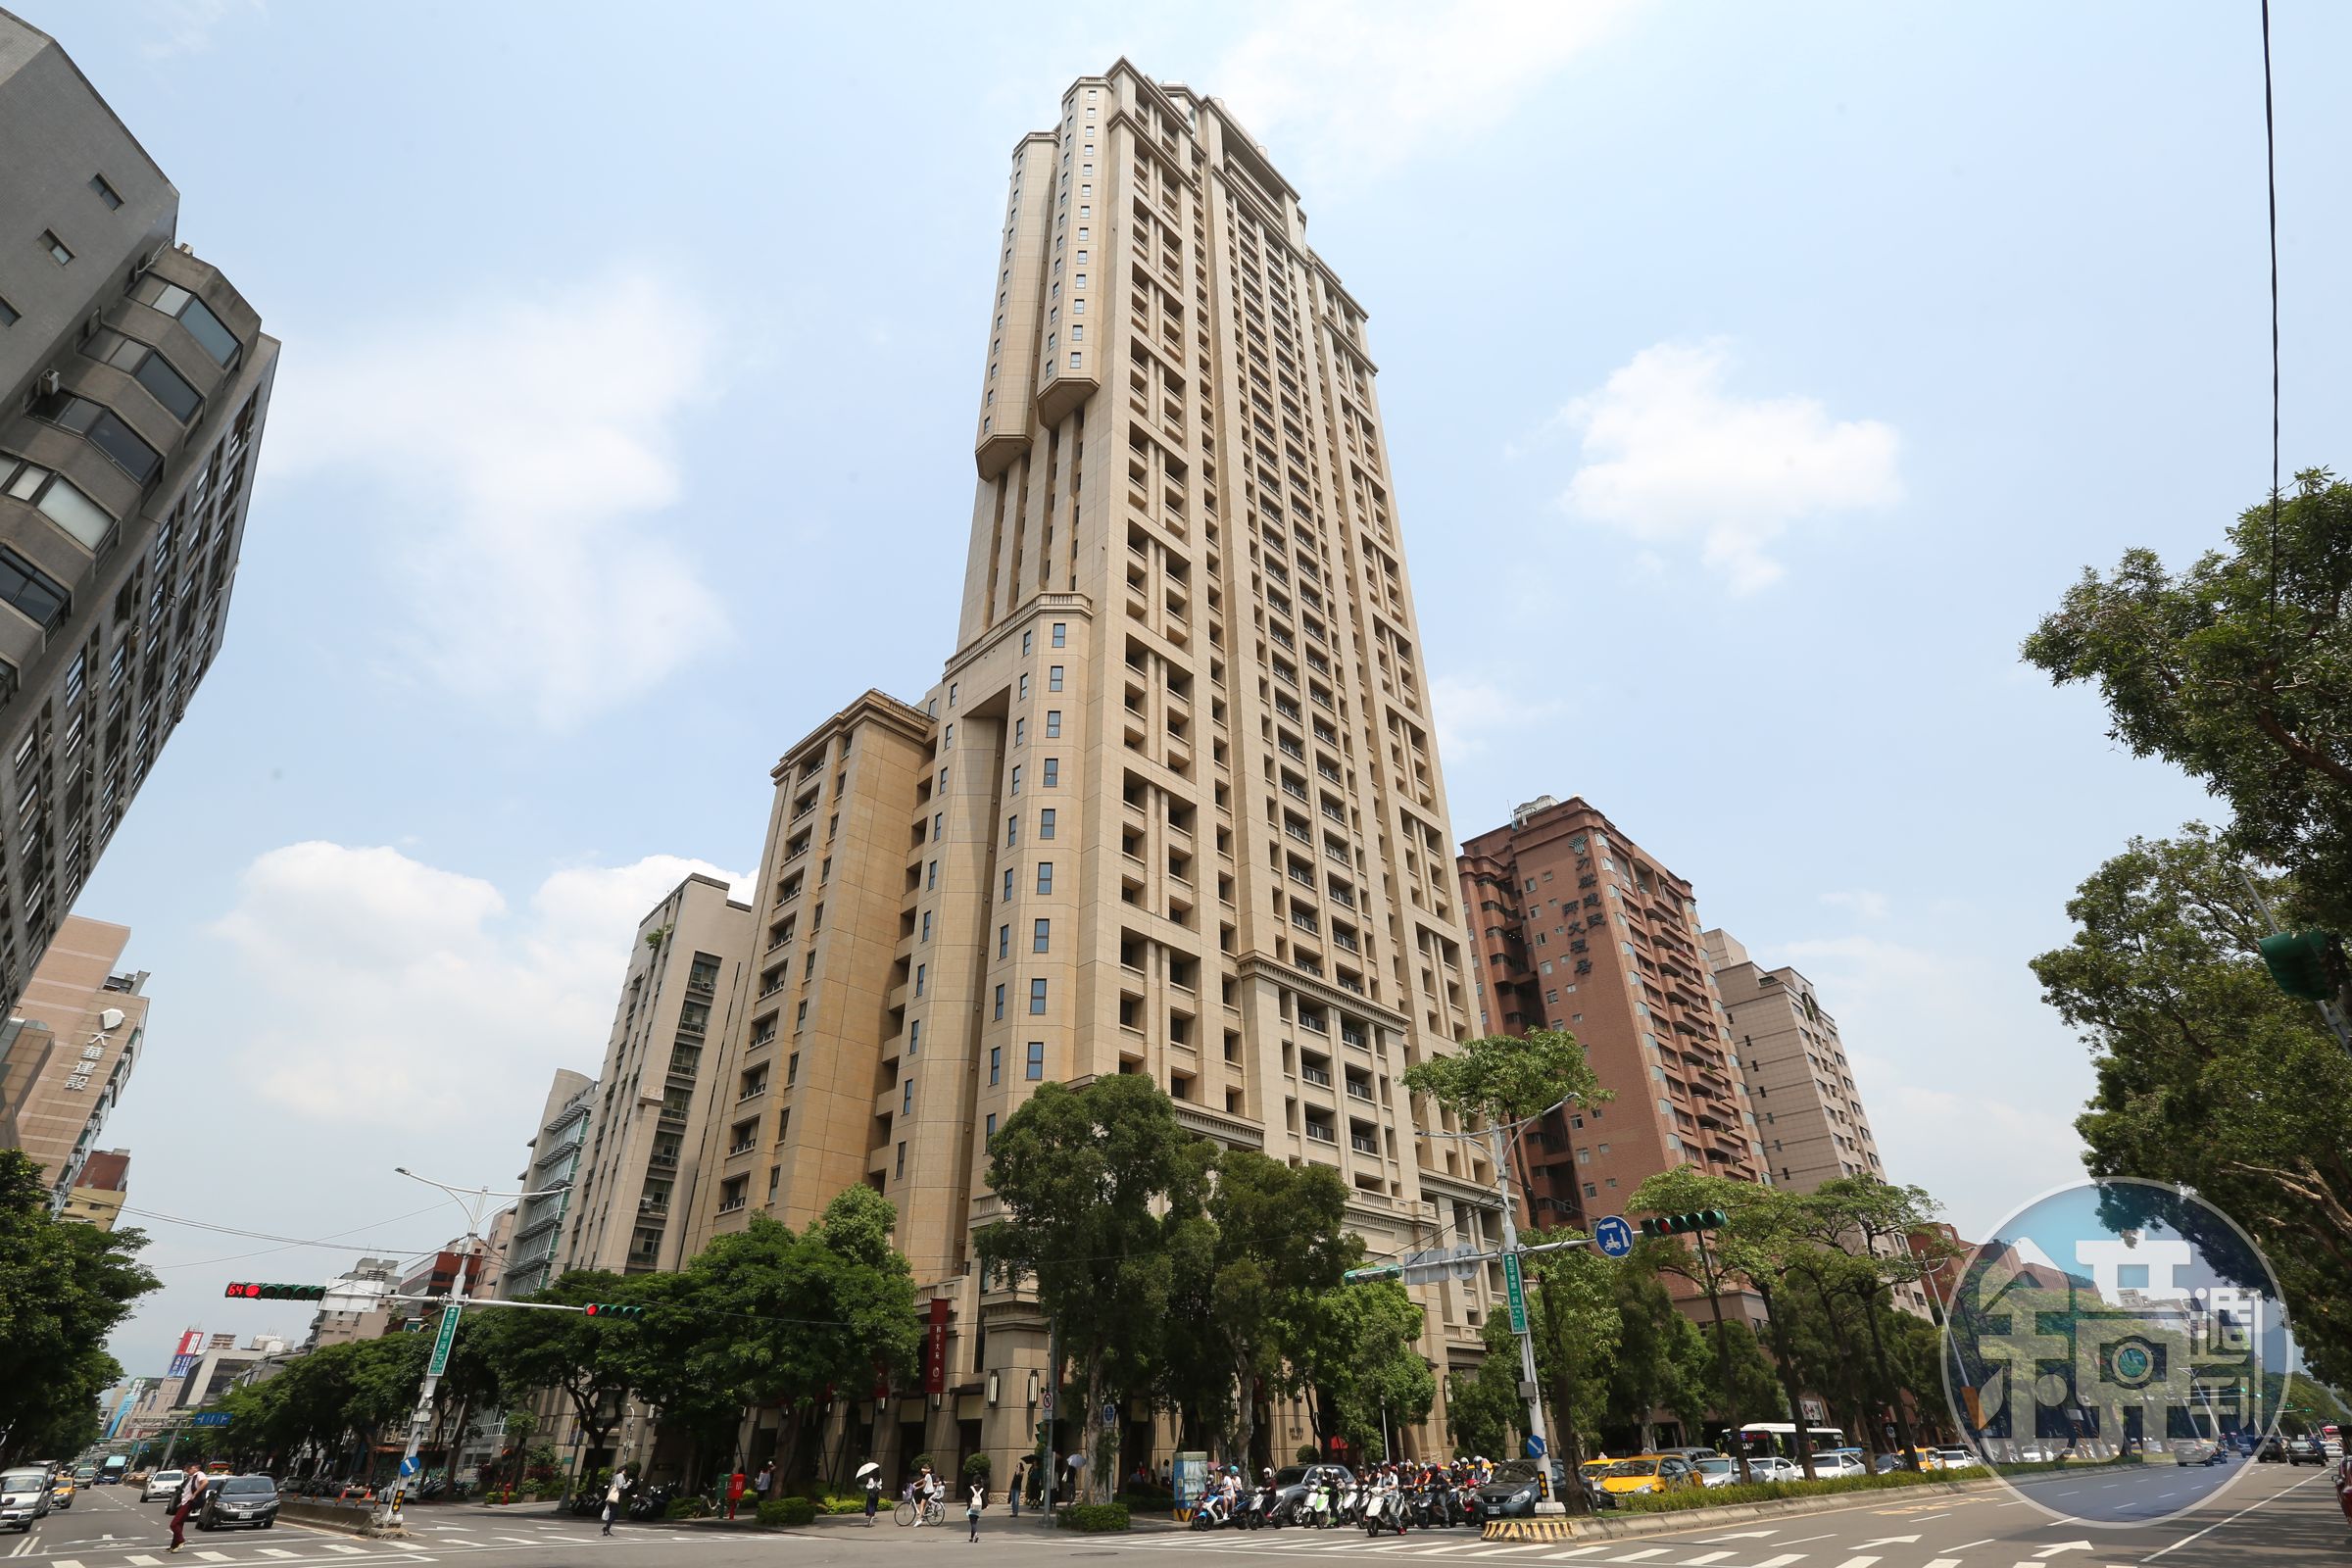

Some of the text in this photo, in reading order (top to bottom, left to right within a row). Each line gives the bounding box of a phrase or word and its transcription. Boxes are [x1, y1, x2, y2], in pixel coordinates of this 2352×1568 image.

[64, 1031, 113, 1091] 大華建設
[227, 1284, 244, 1296] 64
[1507, 1260, 1519, 1303] 和平東路一段
[439, 1312, 456, 1349] 金山南路二段
